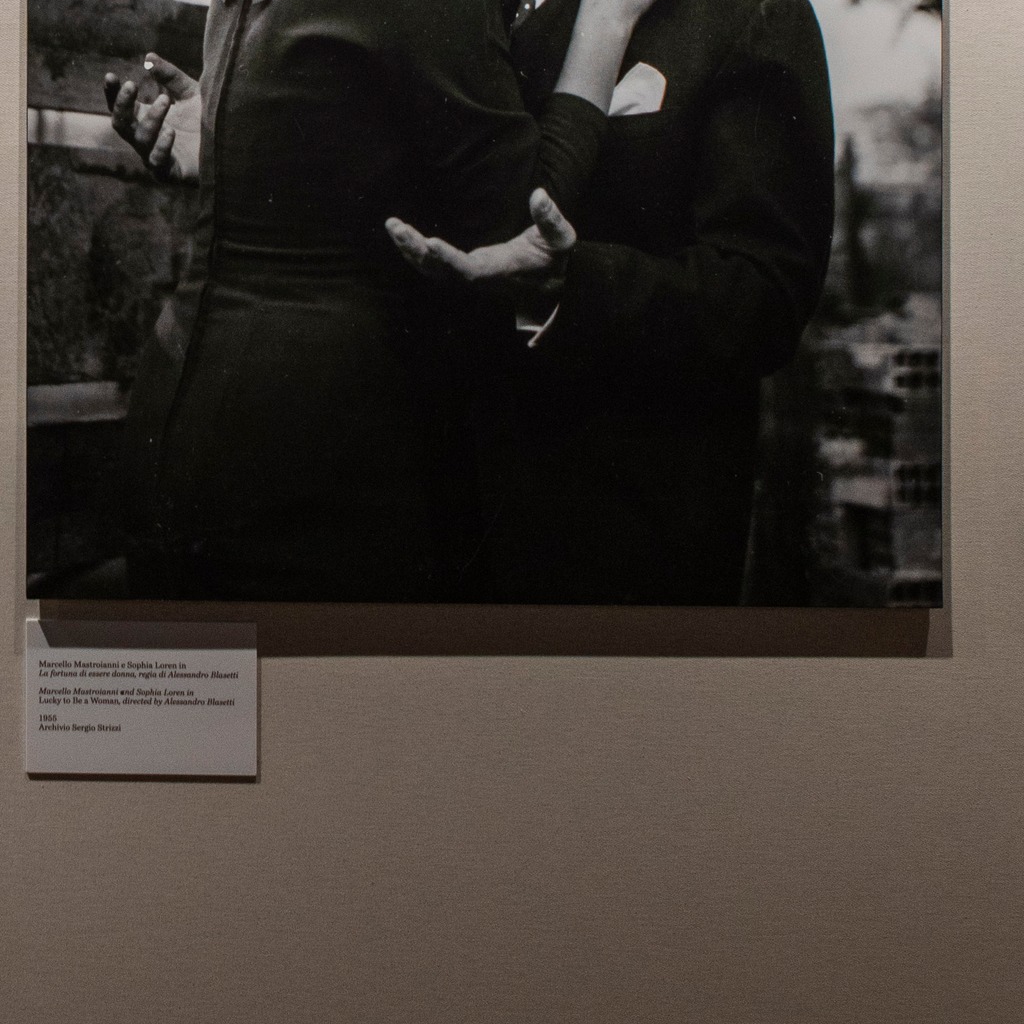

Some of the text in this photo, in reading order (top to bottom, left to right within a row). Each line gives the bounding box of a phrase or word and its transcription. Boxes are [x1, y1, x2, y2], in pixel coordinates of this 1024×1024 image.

[127, 661, 153, 670] Sophia
[50, 670, 77, 678] fortuna
[112, 670, 136, 679] donna,
[139, 671, 157, 679] regia
[136, 688, 161, 697] Sophia
[39, 697, 61, 706] Lucky
[91, 697, 120, 705] Woman,
[154, 698, 162, 706] by
[72, 724, 95, 733] Sergio
